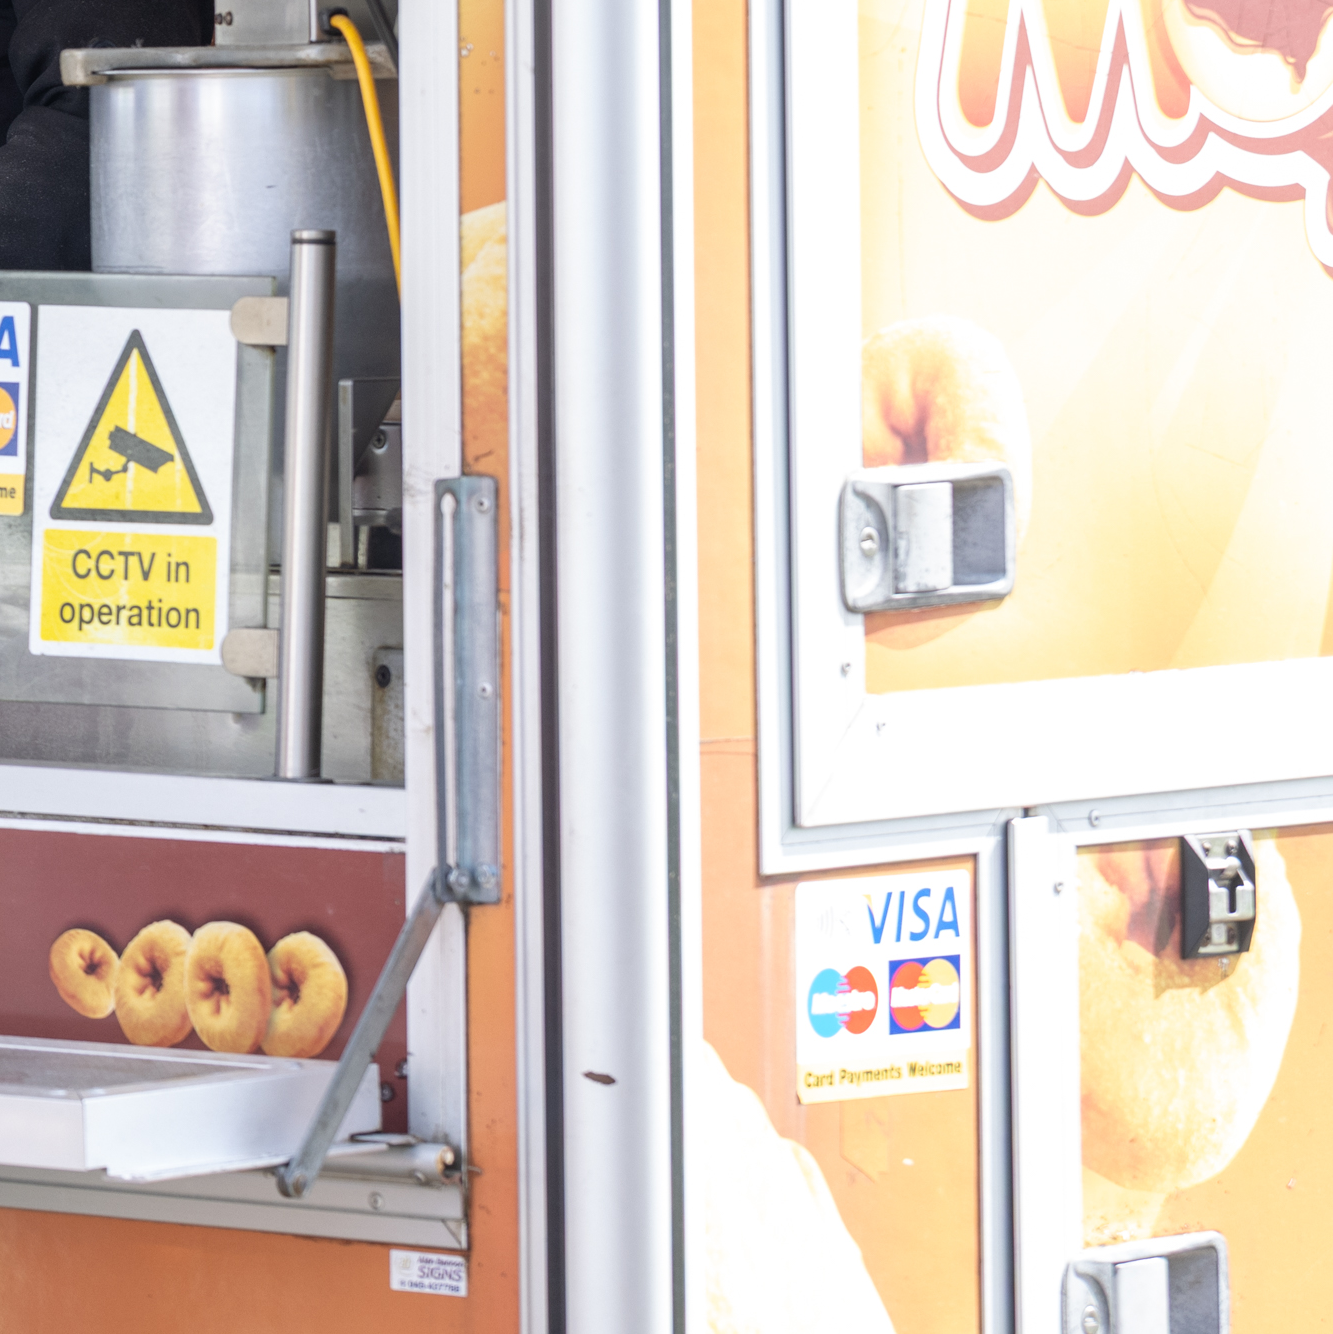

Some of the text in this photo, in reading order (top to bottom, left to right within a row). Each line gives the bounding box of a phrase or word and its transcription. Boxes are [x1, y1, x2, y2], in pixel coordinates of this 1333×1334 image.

[71, 548, 191, 583] CCTV in
[59, 599, 202, 633] operation
[862, 885, 961, 945] VISA
[803, 1060, 962, 1088] Card Payments Welcome
[417, 1264, 463, 1283] SIGNS
